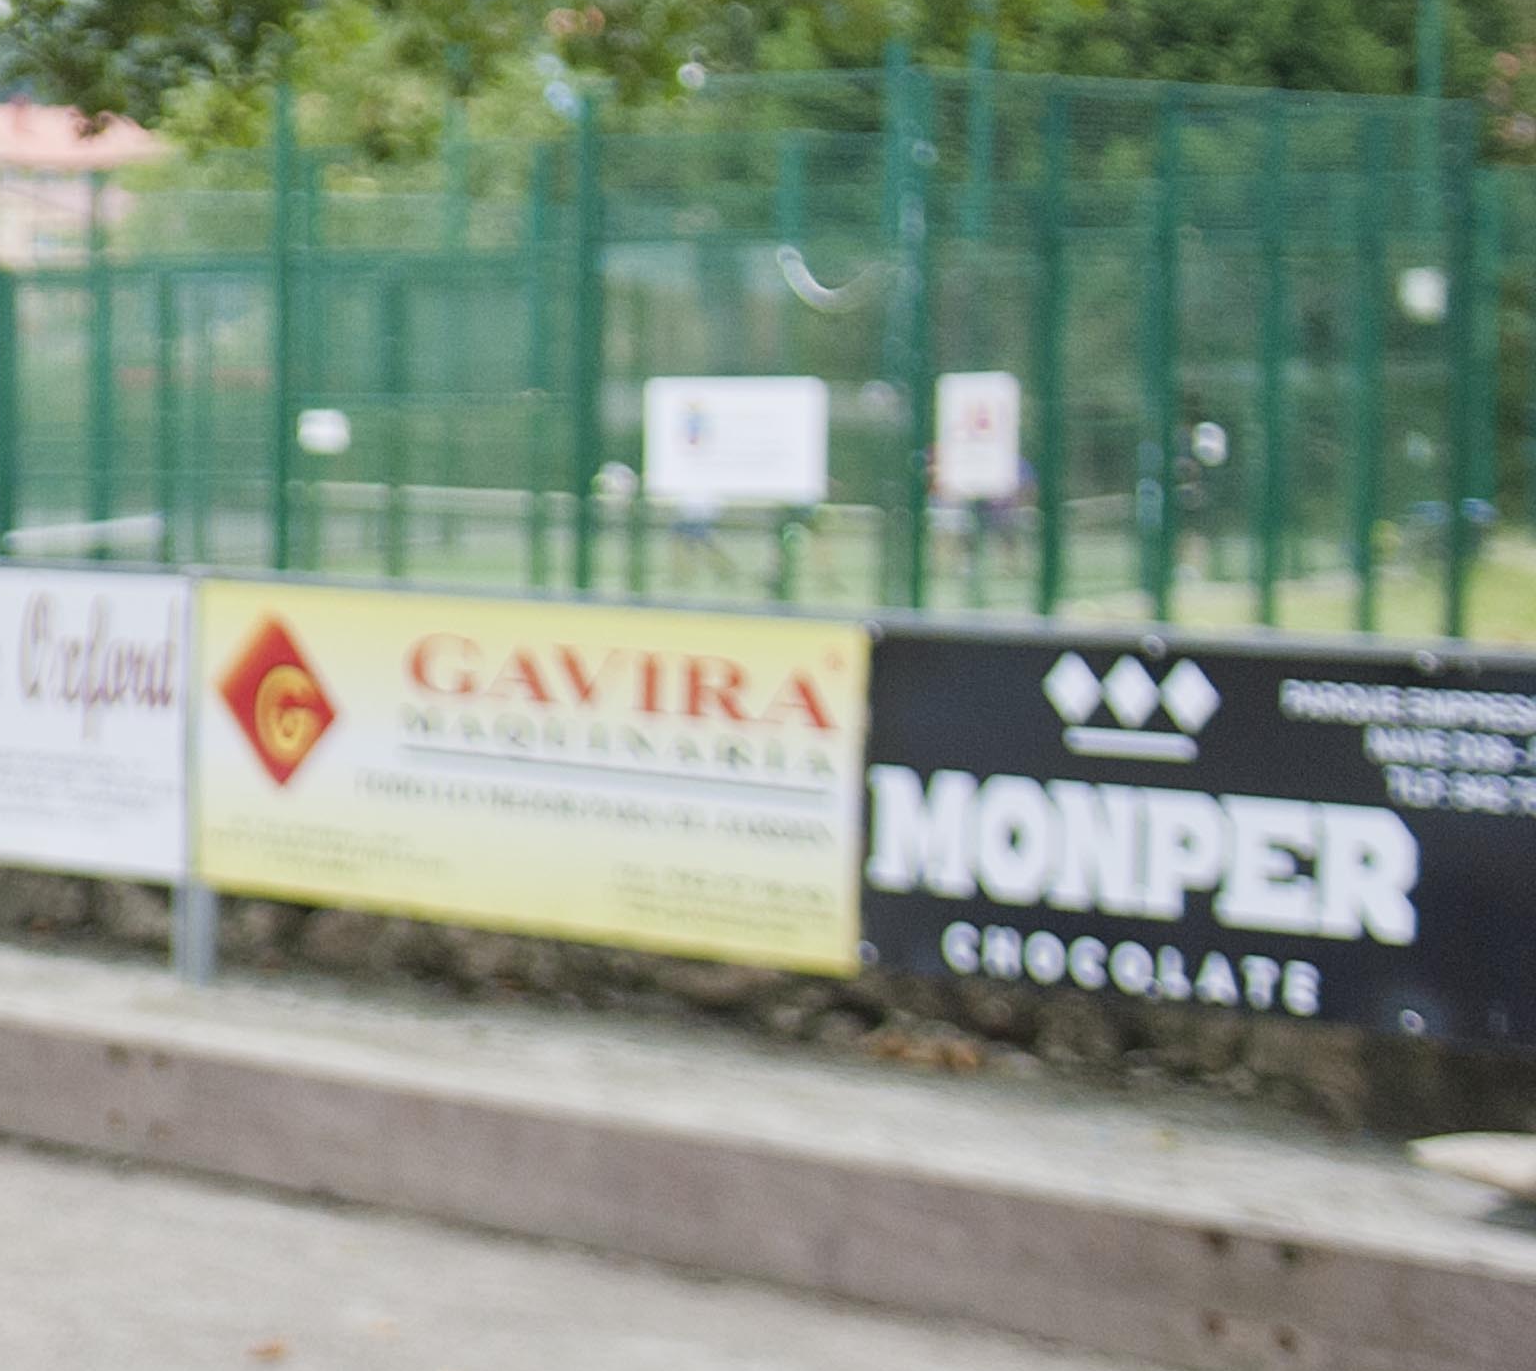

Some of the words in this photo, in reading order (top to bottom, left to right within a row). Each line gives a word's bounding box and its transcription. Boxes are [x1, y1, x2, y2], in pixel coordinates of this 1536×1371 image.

[403, 631, 842, 730] GAVIRA
[398, 699, 839, 778] MAQUINARIA
[865, 763, 1419, 946] MONPER
[940, 919, 1322, 1018] CHOCOLATE
